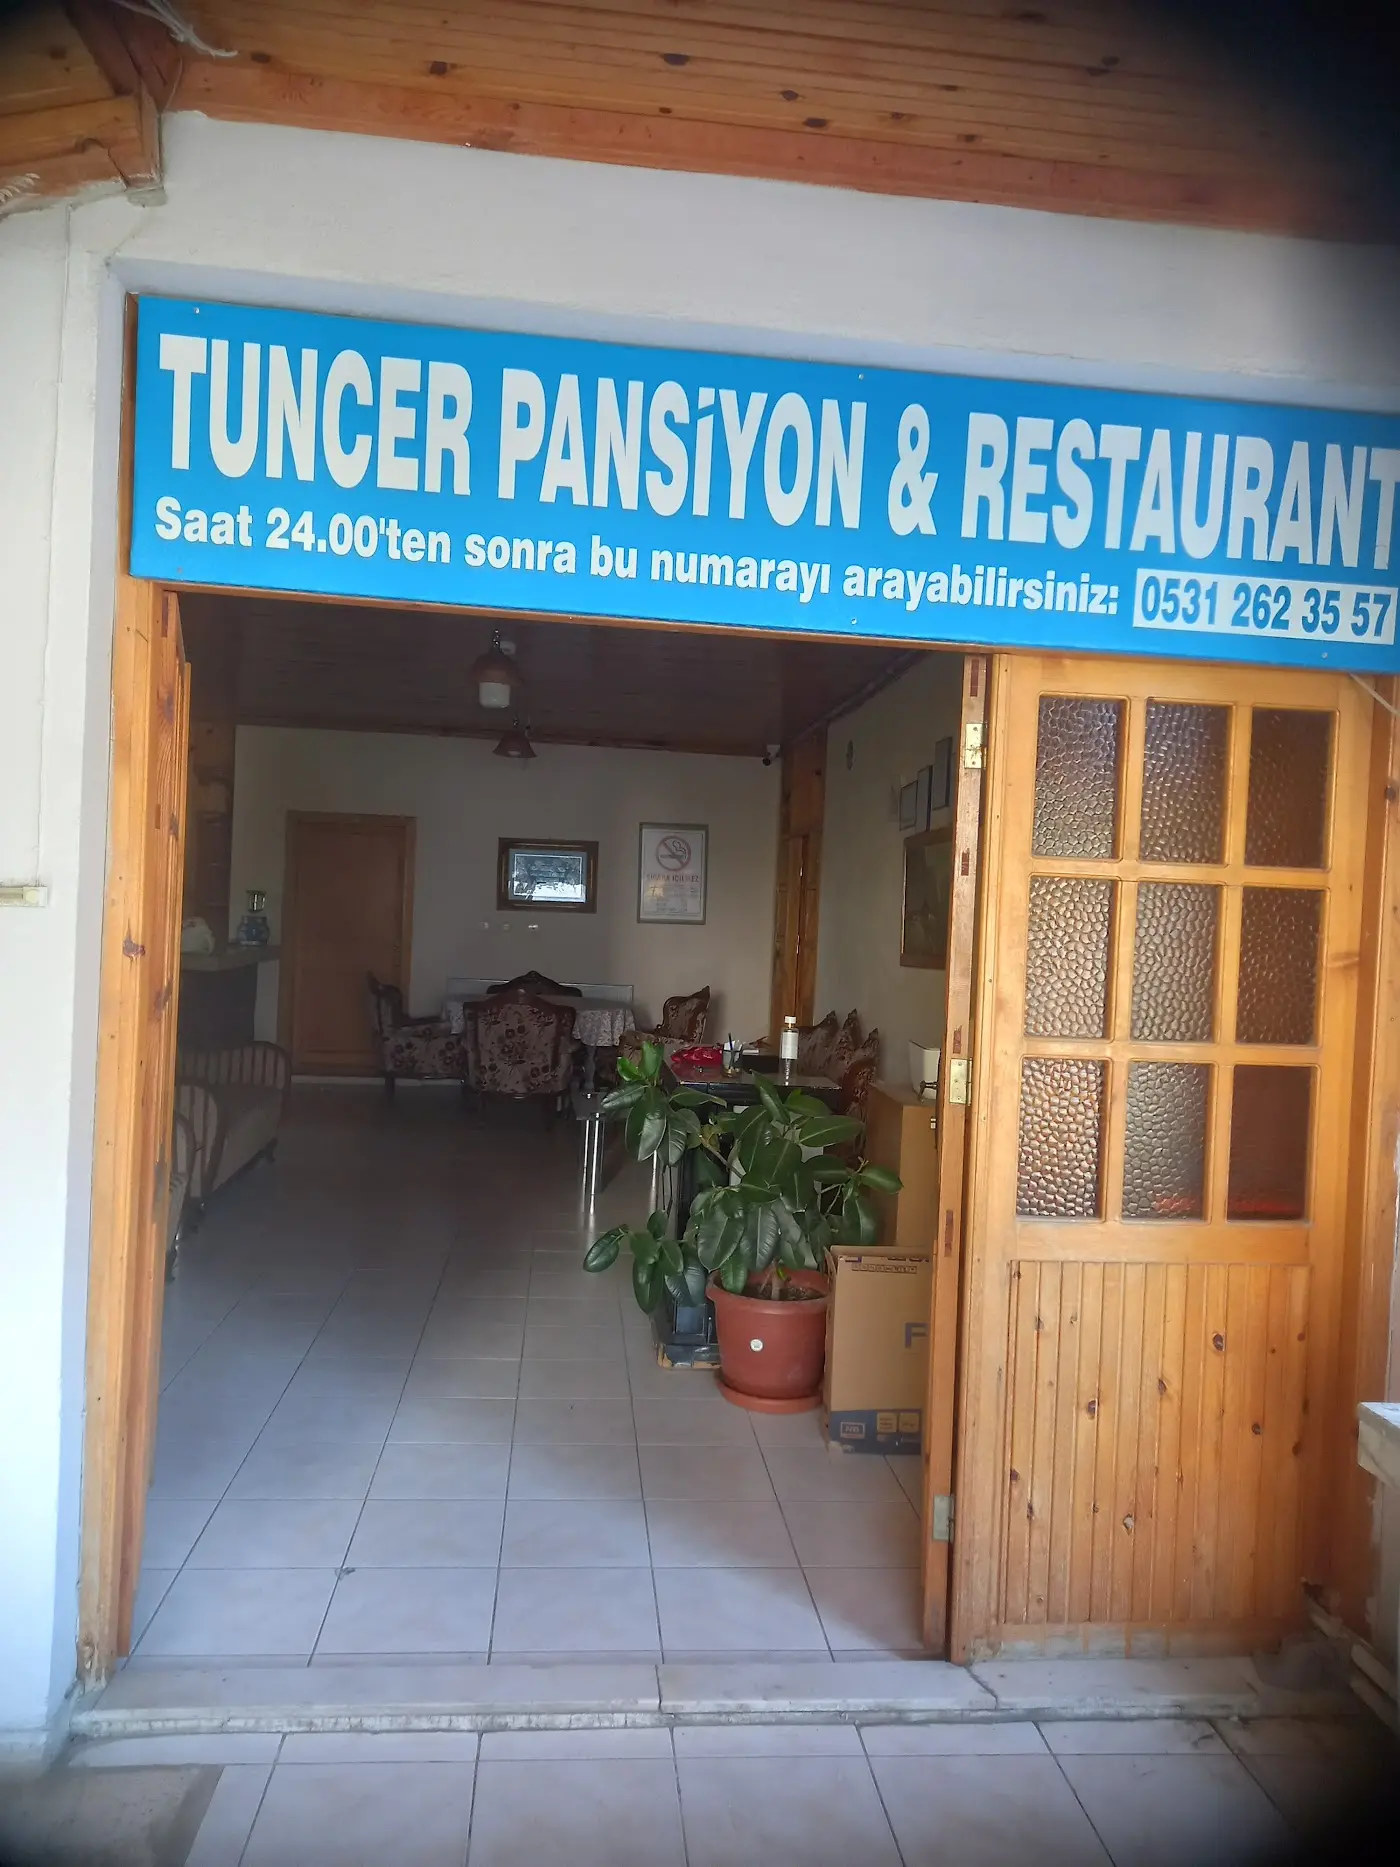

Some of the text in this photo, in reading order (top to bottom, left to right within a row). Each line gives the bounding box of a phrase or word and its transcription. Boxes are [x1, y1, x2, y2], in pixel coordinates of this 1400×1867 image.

[158, 333, 474, 496] TUNCER
[888, 403, 939, 536] &
[960, 411, 1400, 571] RESTAURANT
[155, 496, 1392, 638] Saat 24.00'ten sonra bu numarayı arayabilirsiniz: 0531 262 35 57
